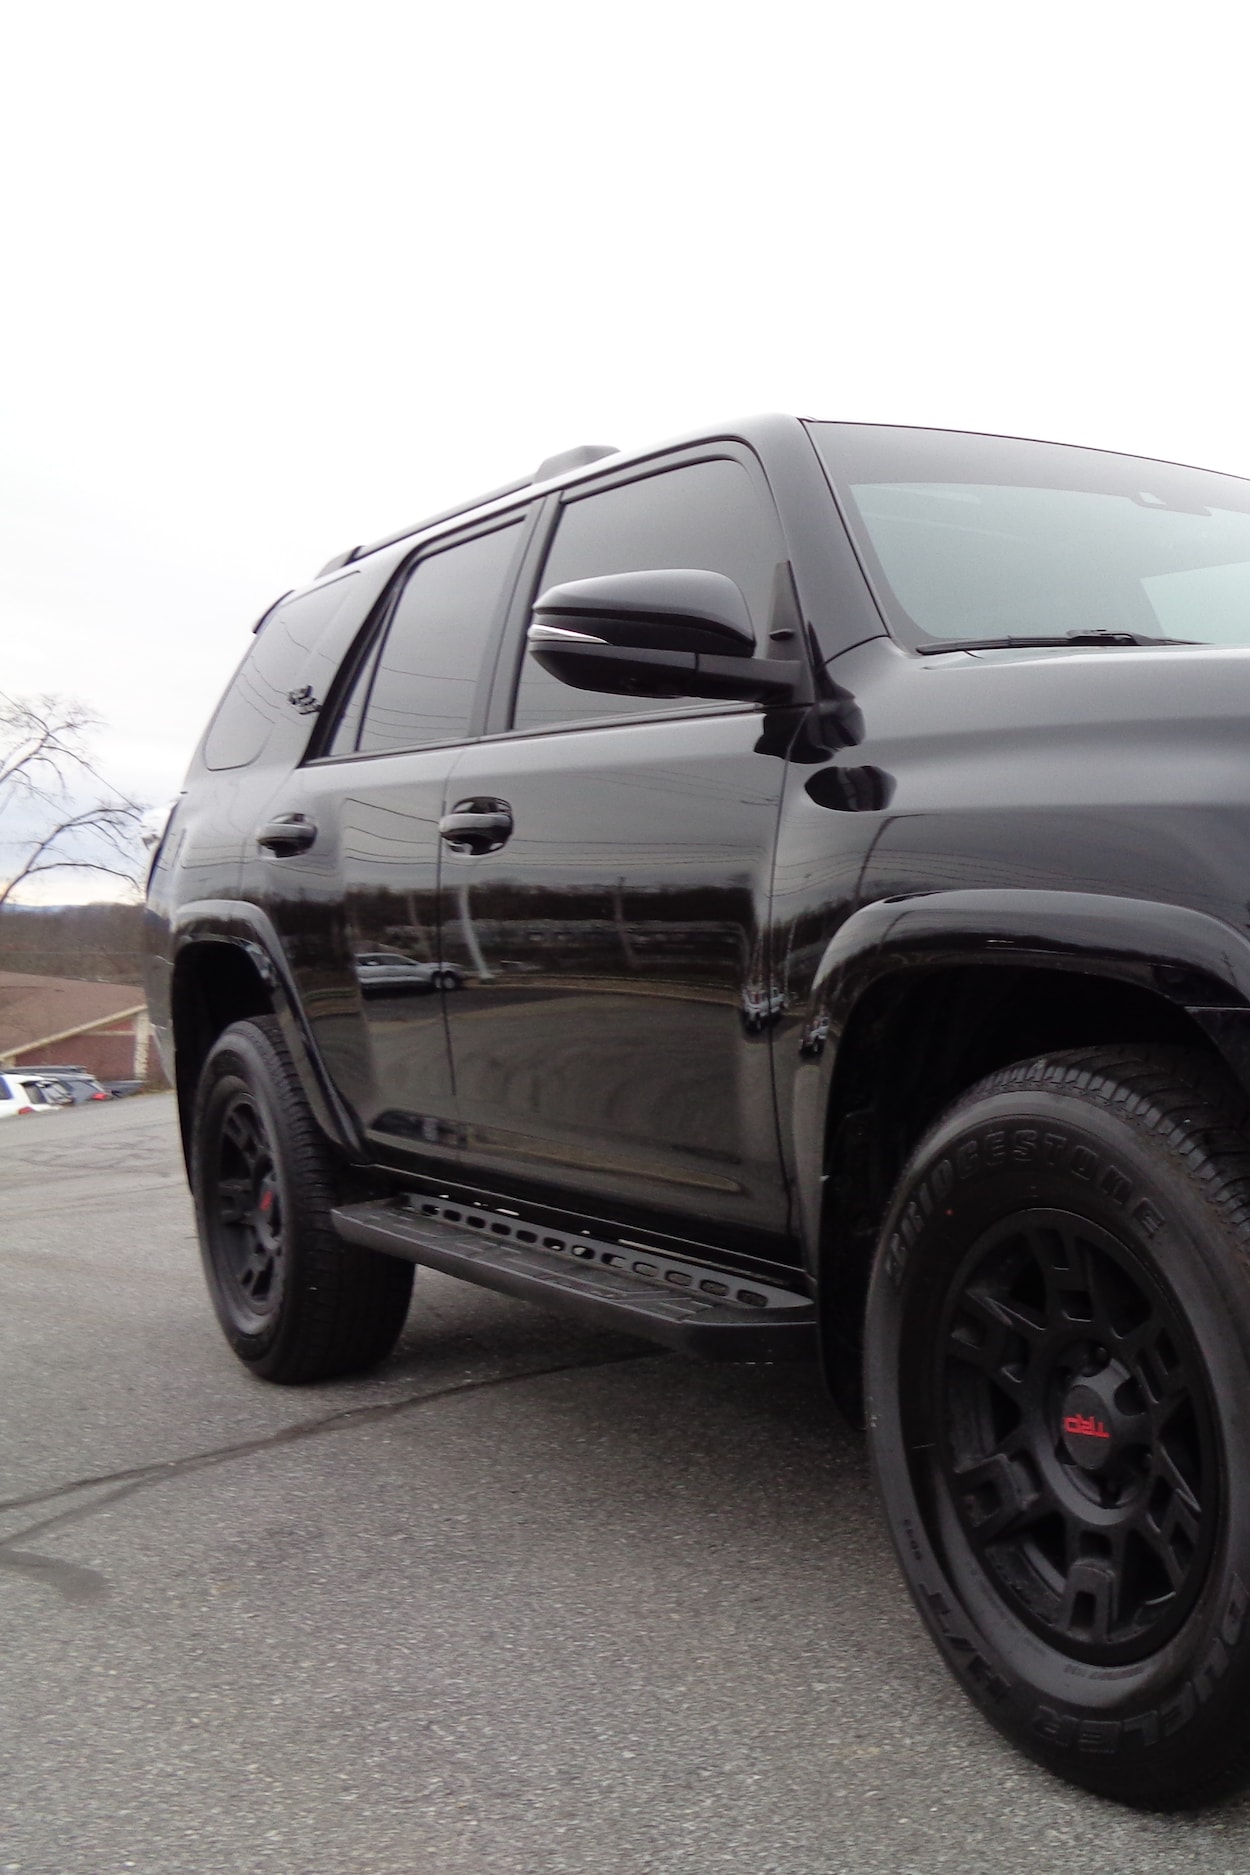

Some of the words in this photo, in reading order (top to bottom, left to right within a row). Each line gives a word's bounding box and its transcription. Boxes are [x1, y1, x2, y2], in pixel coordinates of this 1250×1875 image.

[885, 1129, 1166, 1284] BRIDGESTONE
[1063, 1413, 1110, 1438] TRD
[1031, 1571, 1250, 1754] DUELER
